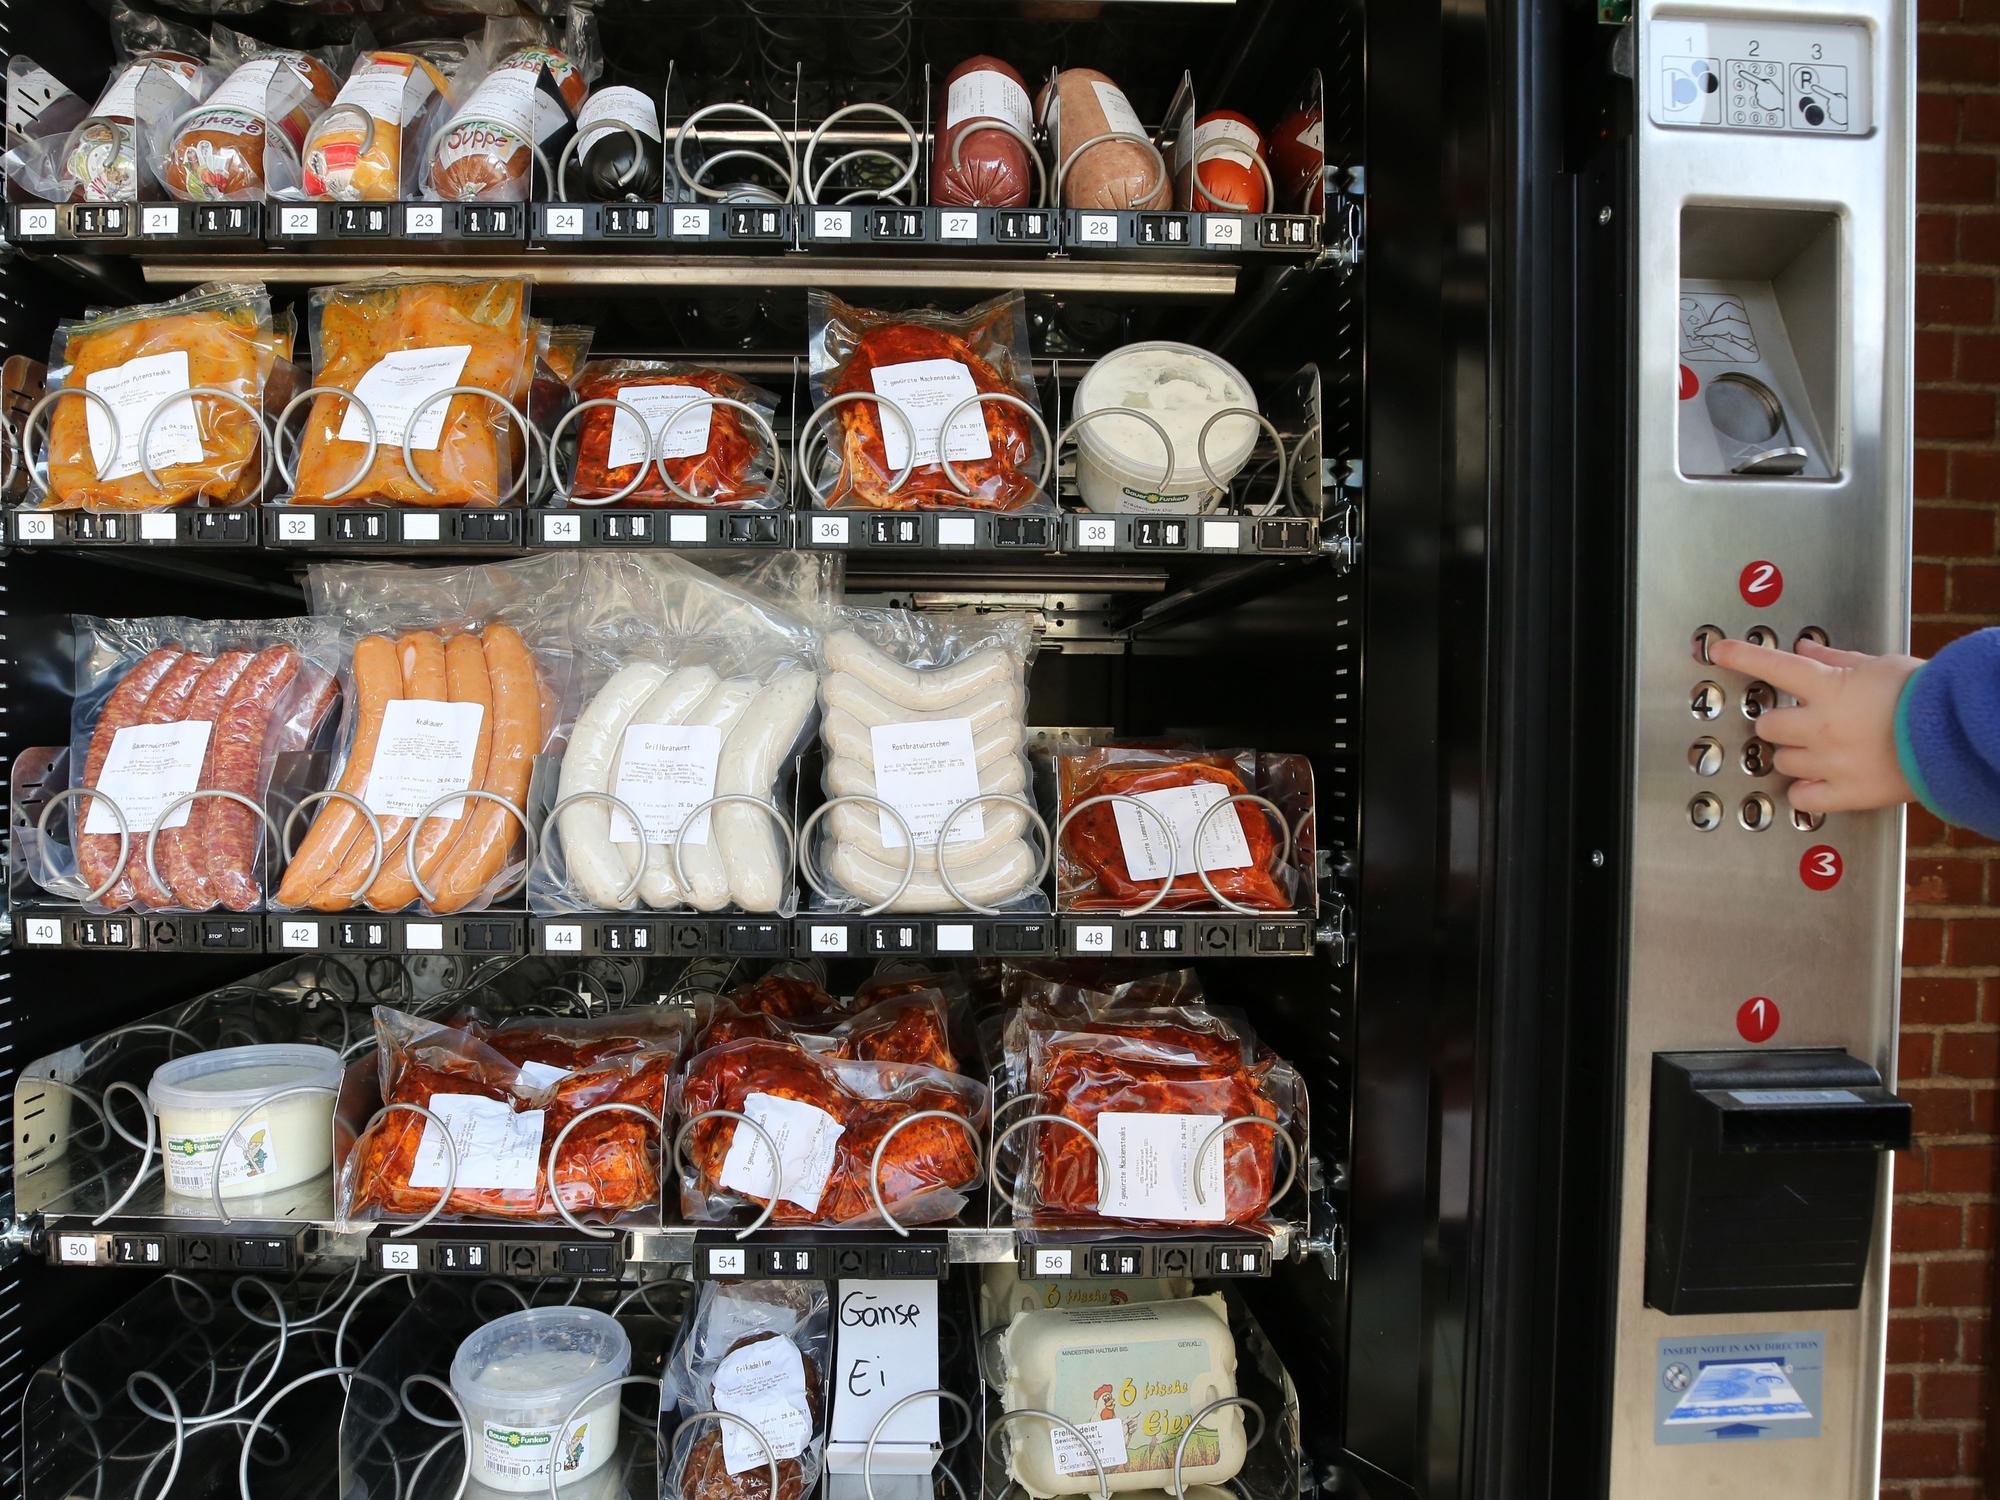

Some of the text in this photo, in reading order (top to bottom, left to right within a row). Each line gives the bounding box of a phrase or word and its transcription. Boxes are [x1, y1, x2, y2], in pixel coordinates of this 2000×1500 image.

[1686, 37, 1823, 60] 1 2 3
[1801, 71, 1812, 89] R
[448, 128, 508, 149] Suppe
[29, 215, 47, 229] 20
[152, 214, 169, 227] 21
[290, 214, 309, 228] 22
[415, 214, 434, 227] 23
[556, 215, 574, 228] 24
[682, 215, 701, 228] 25
[823, 217, 843, 231] 26
[950, 219, 969, 232] 27
[1090, 221, 1109, 235] 28
[1214, 224, 1233, 238] 29
[27, 520, 46, 534] 30
[288, 521, 306, 534] 32
[553, 522, 571, 535] 34
[821, 524, 840, 537] 36
[1088, 526, 1106, 540] 38
[1748, 565, 1775, 594] 2
[1695, 632, 1710, 664] 1
[1691, 687, 1761, 719] 4 5
[416, 718, 444, 728] Krakauer
[644, 742, 691, 752] Grillbratwurst
[1691, 744, 1763, 774] 7 8
[1691, 800, 1710, 829] C
[1810, 852, 1836, 877] 3
[36, 925, 53, 938] 40
[291, 928, 309, 941] 42
[555, 932, 573, 944] 44
[1085, 932, 1103, 945] 48
[820, 933, 838, 945] 46
[1750, 1000, 1766, 1030] 1
[194, 1141, 220, 1151] Funken
[1119, 1126, 1127, 1169] Nackensteaks
[70, 1243, 88, 1255] 50
[391, 1251, 409, 1263] 52
[718, 1256, 736, 1268] 54
[1045, 1256, 1063, 1268] 56
[1044, 1284, 1107, 1308] 6 frische
[841, 1291, 920, 1328] Gänse
[1062, 1349, 1094, 1357] MINDESTENS
[1663, 1340, 1819, 1356] INSERT NOTE IN ANY DIRECTION
[735, 1359, 772, 1376] Frikadellen
[849, 1356, 885, 1397] Ei
[1119, 1377, 1188, 1407] 6 frische
[1143, 1408, 1193, 1437] Eier
[489, 1431, 549, 1444] Bauer Funken
